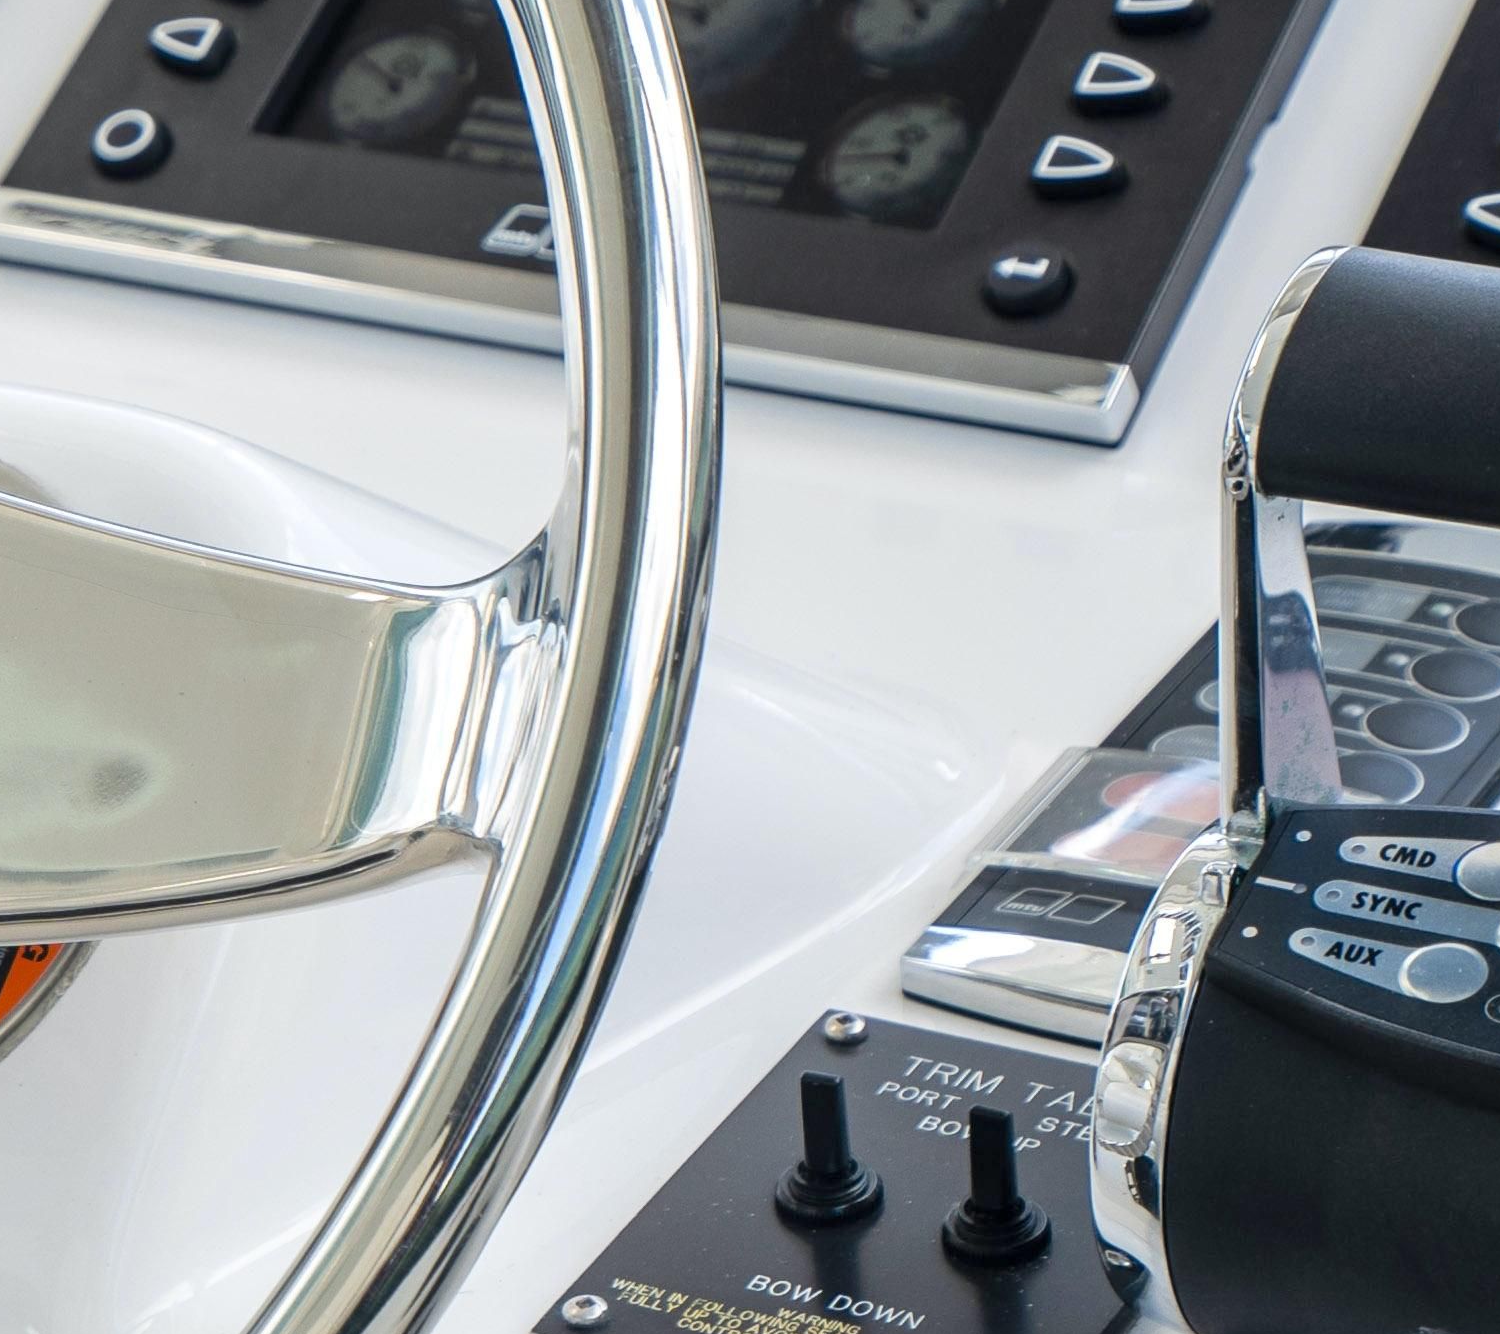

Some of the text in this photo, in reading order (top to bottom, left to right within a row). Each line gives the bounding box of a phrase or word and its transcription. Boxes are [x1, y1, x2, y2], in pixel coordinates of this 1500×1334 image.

[1378, 843, 1437, 869] CMD
[1003, 901, 1046, 914] mtu
[1351, 892, 1424, 921] SYNC
[1324, 940, 1384, 968] AUX
[903, 1055, 1005, 1096] TRIM
[876, 1080, 963, 1111] PORT
[611, 1277, 665, 1300] WHEN
[667, 1291, 689, 1305] IN
[692, 1297, 801, 1333] FOLLOWING
[616, 1292, 676, 1314] FULLY
[682, 1306, 711, 1322] UP
[717, 1314, 742, 1330] TO
[745, 1274, 926, 1331] BOW DOWN
